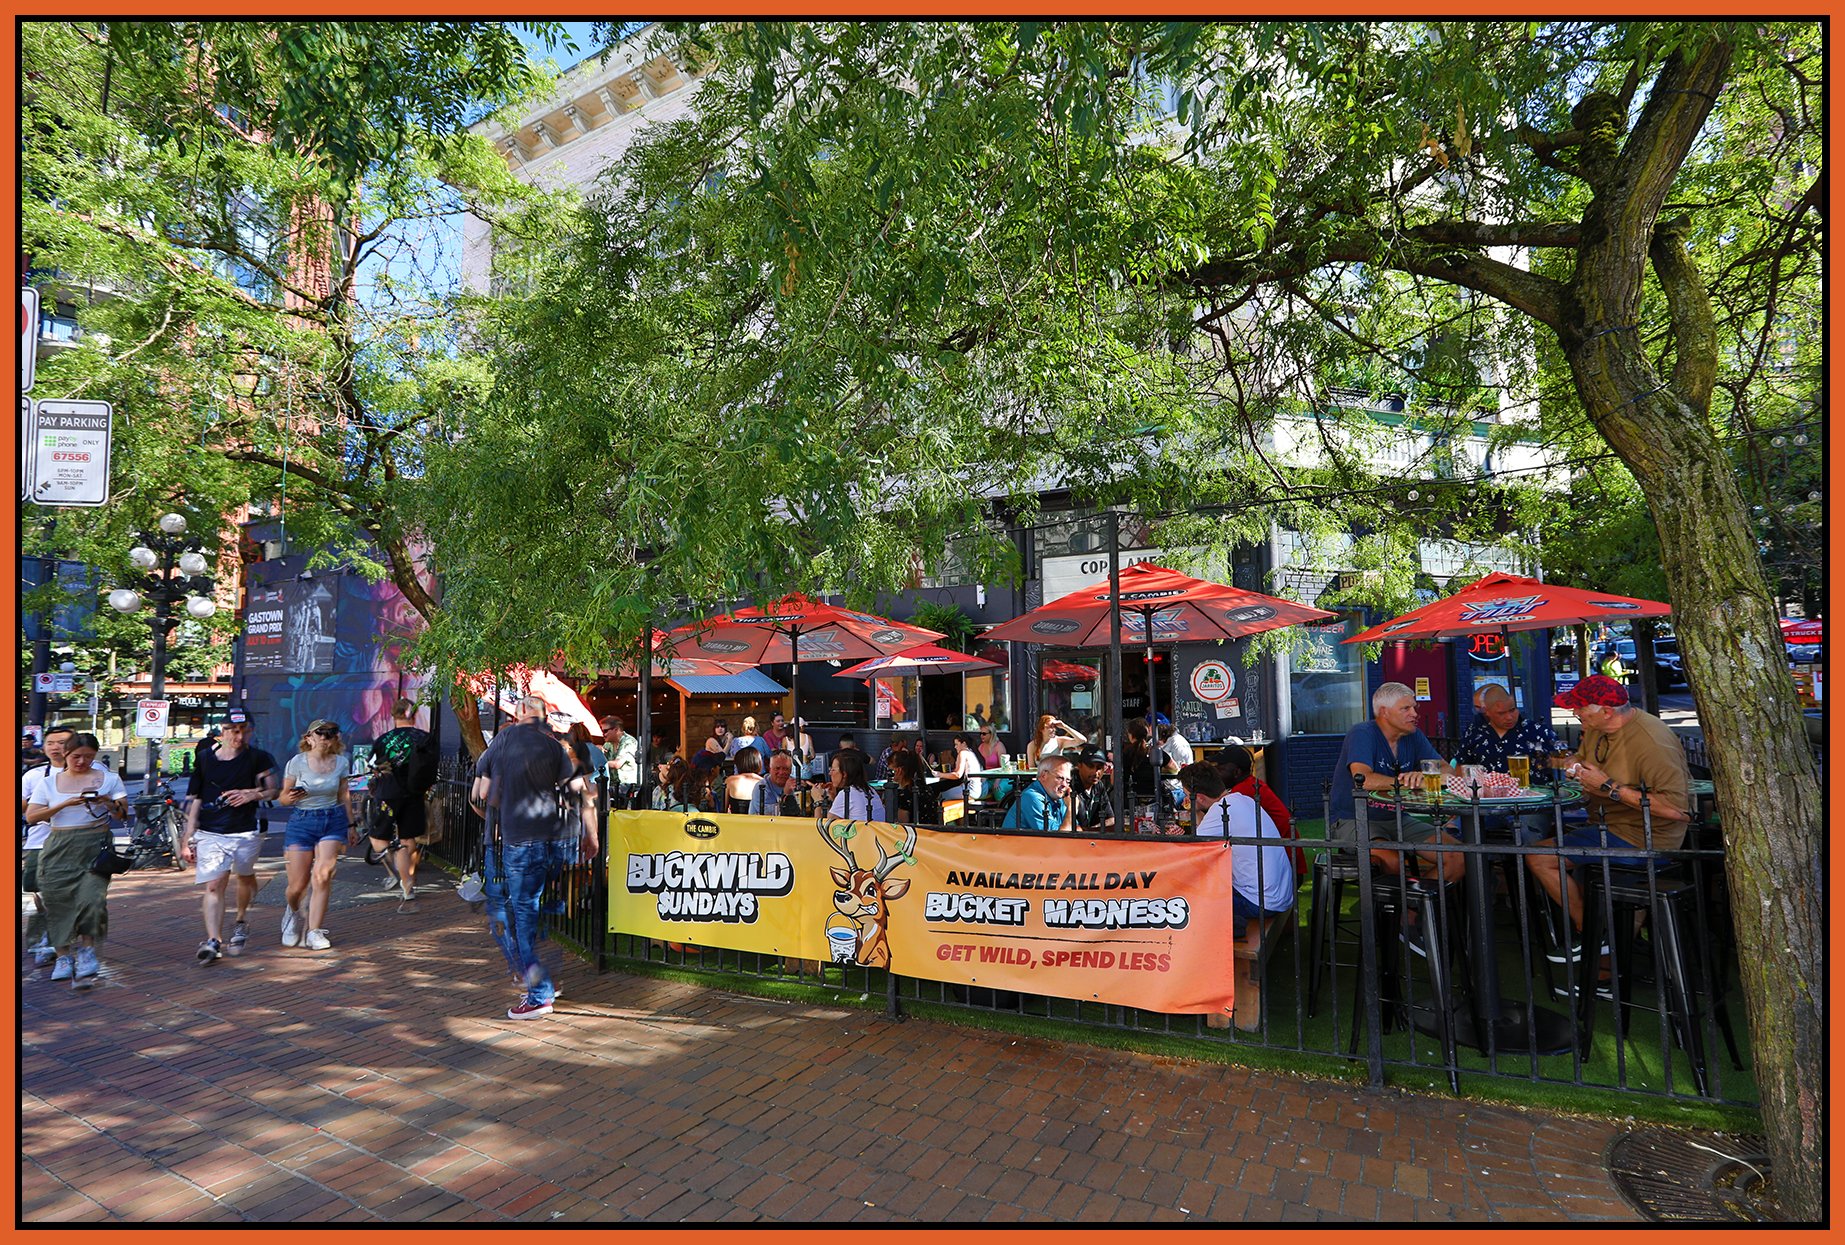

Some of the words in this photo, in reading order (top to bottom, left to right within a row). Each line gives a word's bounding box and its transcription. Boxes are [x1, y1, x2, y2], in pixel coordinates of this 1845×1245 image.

[39, 416, 58, 427] PAY
[60, 417, 107, 428] PARKING
[53, 453, 89, 461] 67556
[1081, 560, 1108, 575] COP
[248, 609, 284, 624] GASTOWN
[1458, 600, 1549, 621] TILT
[1480, 616, 1526, 624] LAGER
[248, 625, 269, 635] GRAND
[269, 622, 283, 633] PRIX
[1320, 624, 1345, 633] BEER
[686, 824, 697, 832] THE
[697, 824, 717, 834] CAMBIE
[627, 851, 794, 896] BUCKWILD
[946, 871, 1059, 890] AVAILABLE
[1060, 873, 1099, 890] ALL
[1104, 872, 1157, 889] DAY
[925, 892, 1030, 926] BUCKET
[1044, 897, 1189, 929] MADNESS
[936, 944, 975, 961] GET
[974, 946, 1037, 969] WILD,
[1042, 951, 1115, 969] SPEND
[1119, 952, 1171, 972] LESS
